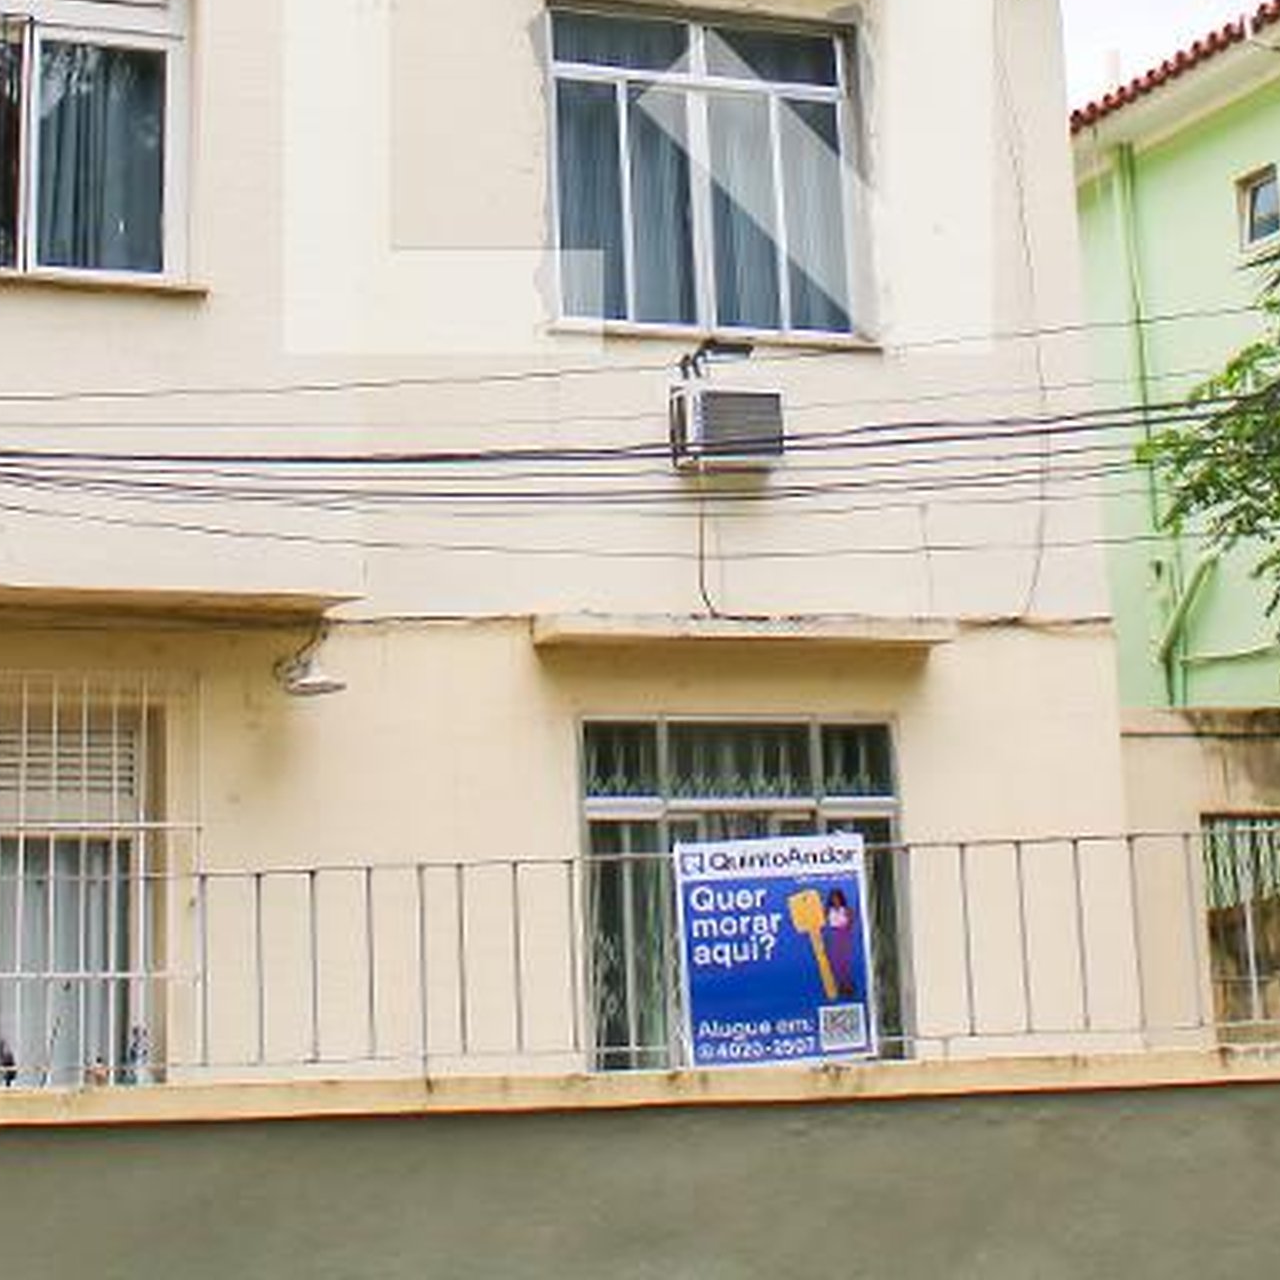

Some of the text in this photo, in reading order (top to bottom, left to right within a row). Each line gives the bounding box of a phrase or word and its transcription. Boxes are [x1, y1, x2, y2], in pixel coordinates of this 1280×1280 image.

[709, 846, 857, 870] QuintoAndar
[691, 886, 767, 911] Quer
[693, 914, 782, 938] morar
[693, 933, 776, 967] aqui?
[698, 1020, 771, 1040] Alugue
